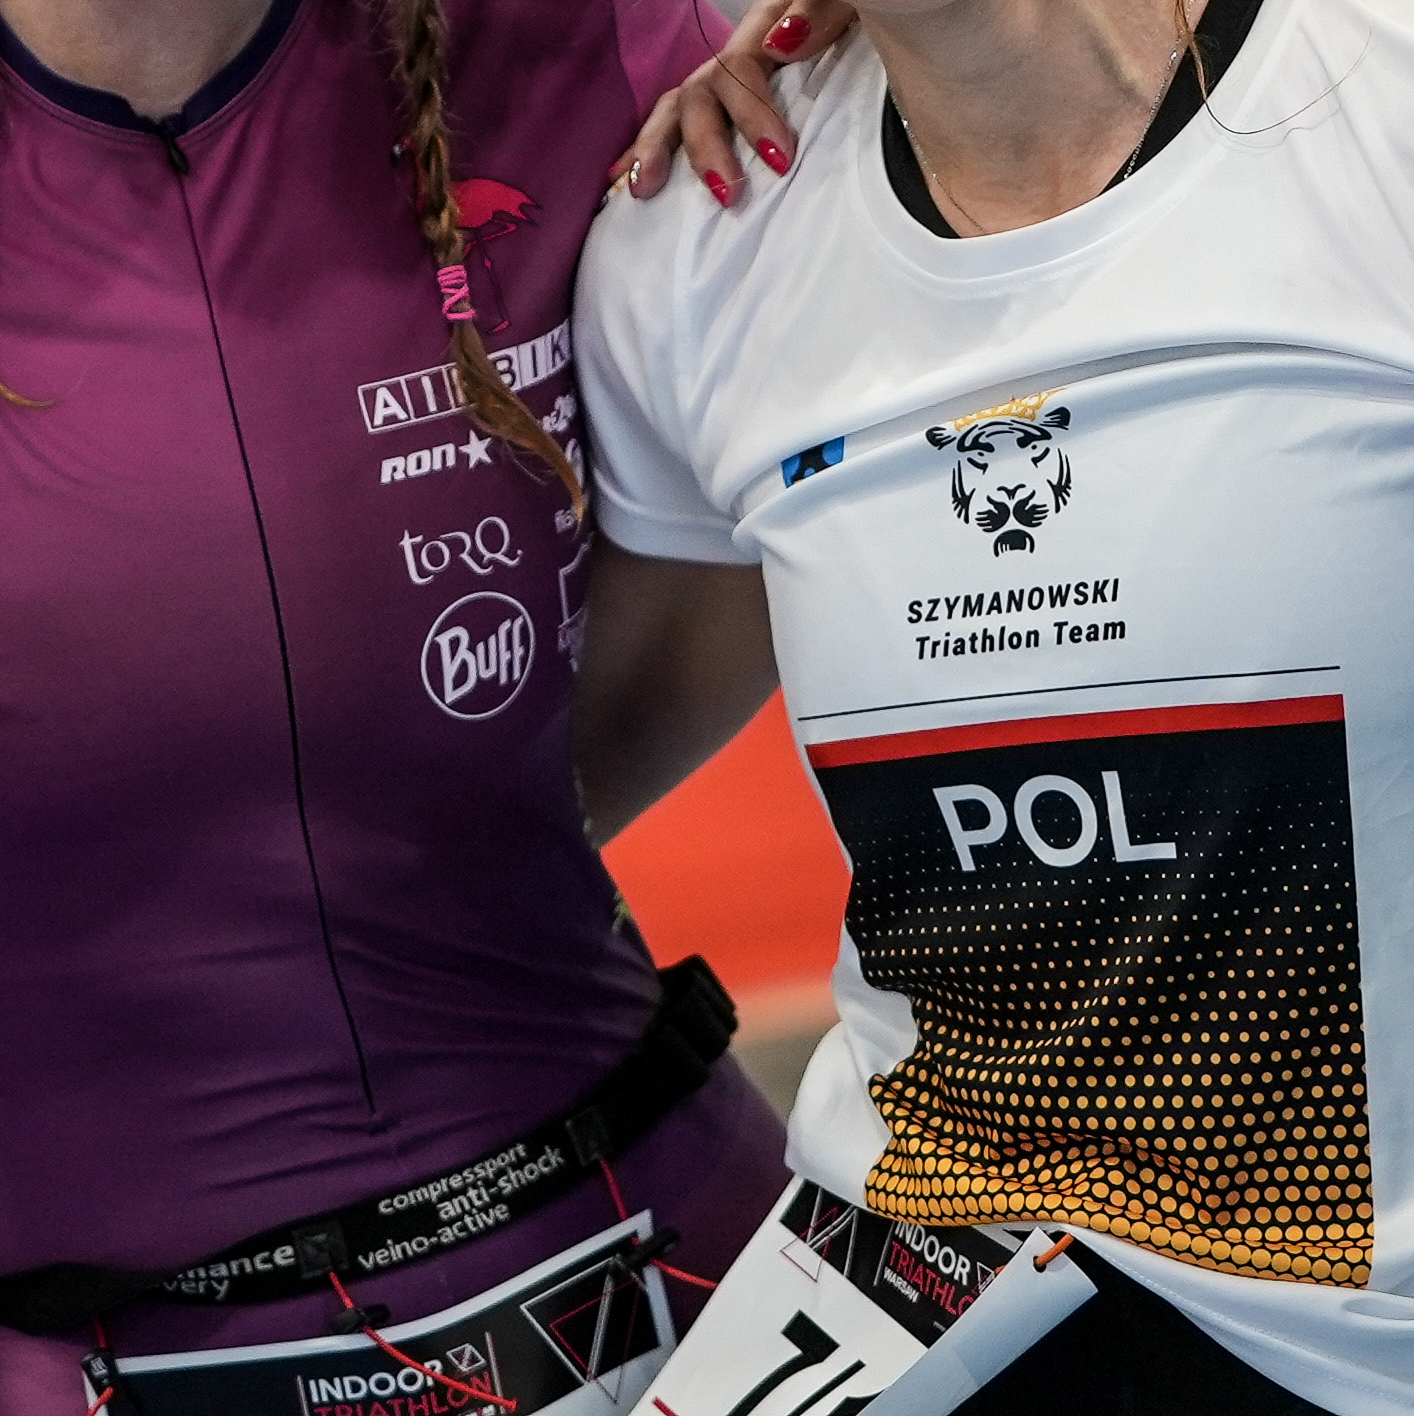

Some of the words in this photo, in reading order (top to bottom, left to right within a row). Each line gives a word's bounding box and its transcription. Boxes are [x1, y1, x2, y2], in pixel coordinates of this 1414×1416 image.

[907, 578, 1120, 625] SZYMANOWSKI
[915, 625, 1040, 661] Triathlon
[1053, 620, 1127, 646] Team
[932, 770, 1178, 873] POL
[377, 1142, 527, 1216] compressport
[436, 1144, 566, 1221] anti-shock
[357, 1202, 511, 1270] veino-active
[894, 1220, 971, 1286] INDOOR
[308, 1358, 444, 1404] INDOOR
